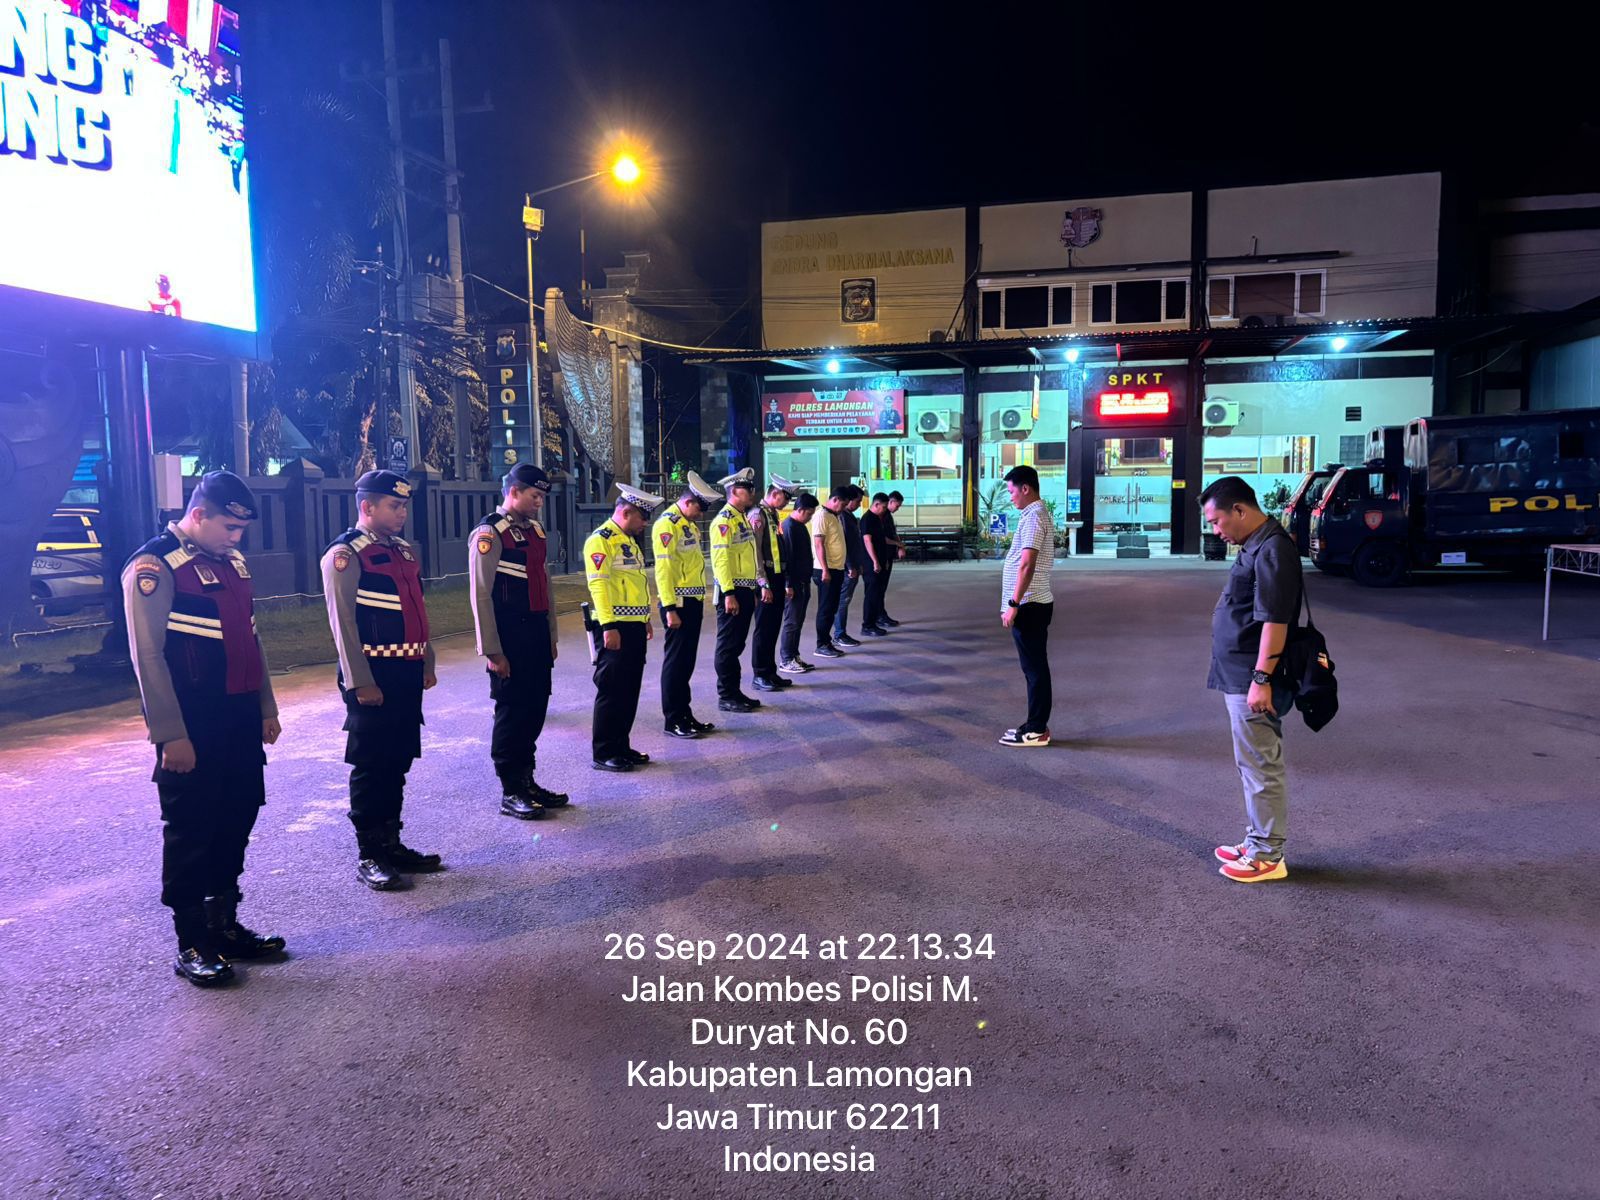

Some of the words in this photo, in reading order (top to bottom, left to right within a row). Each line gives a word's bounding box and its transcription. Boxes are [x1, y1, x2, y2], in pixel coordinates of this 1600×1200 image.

[1108, 373, 1163, 386] SPKT
[790, 404, 822, 412] POLRES
[824, 402, 873, 411] LAMONGAN
[990, 514, 999, 525] P
